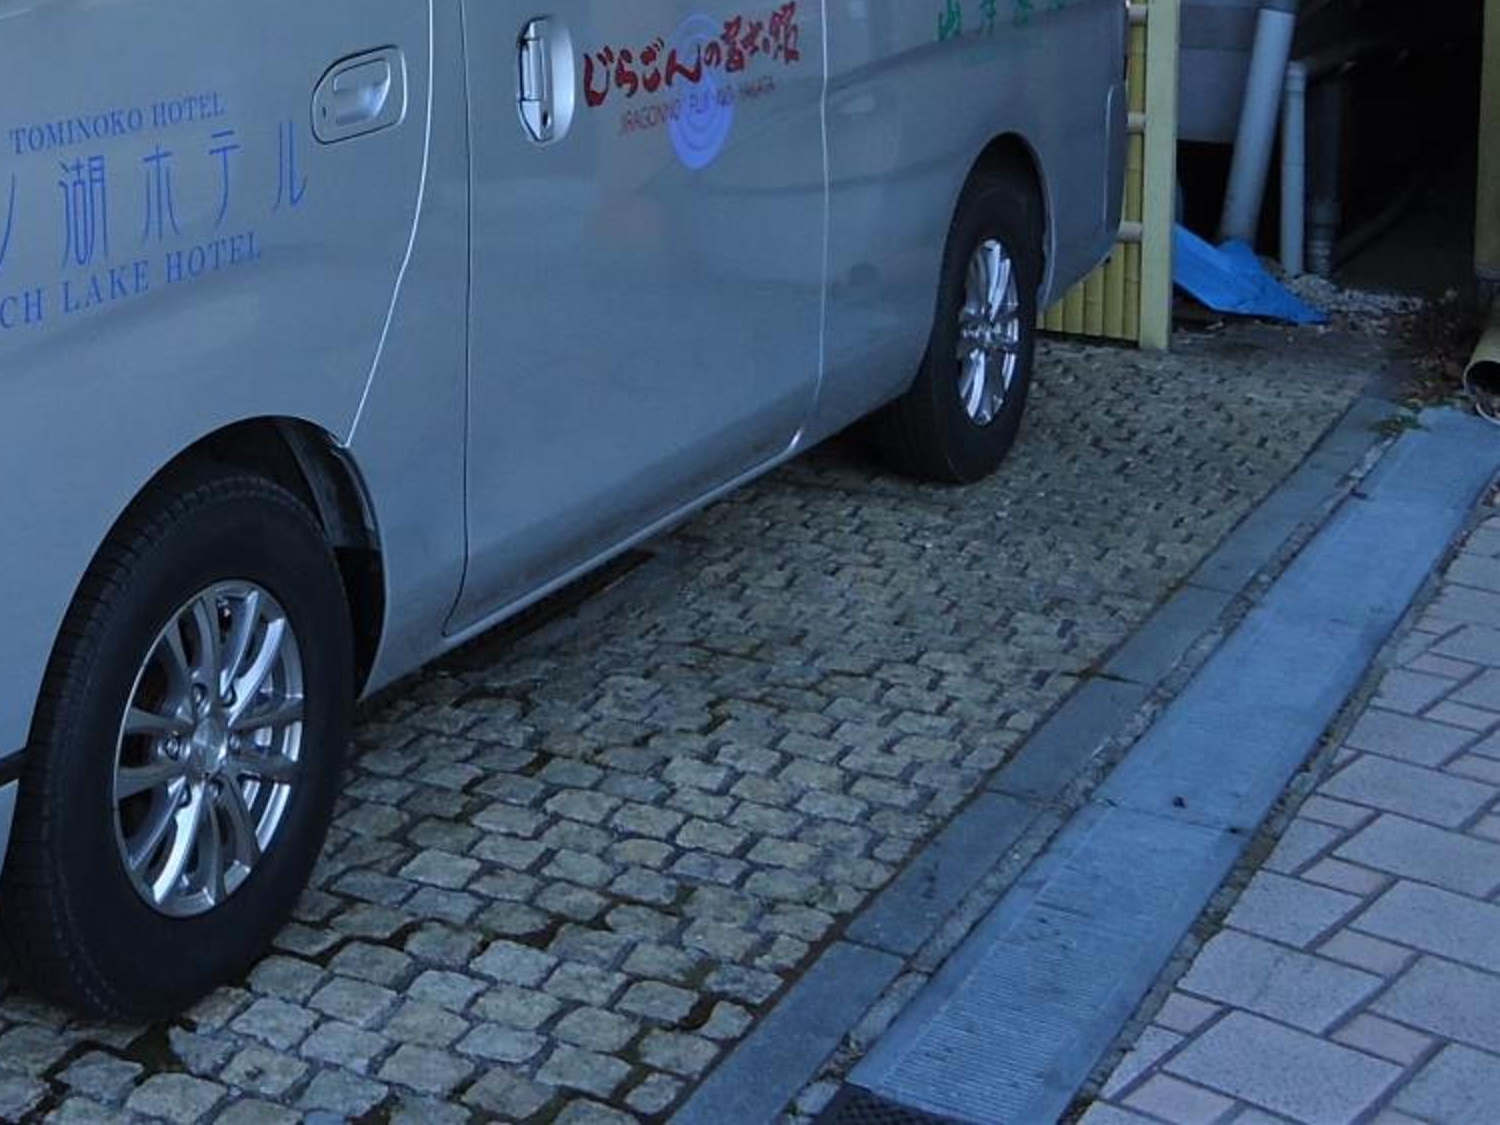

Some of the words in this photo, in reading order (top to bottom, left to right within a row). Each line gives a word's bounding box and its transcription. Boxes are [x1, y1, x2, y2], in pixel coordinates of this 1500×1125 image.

[9, 108, 143, 155] TOMINOKO
[151, 90, 226, 128] HOTEL
[62, 259, 150, 314] LAKE
[166, 231, 263, 284] HOTEL
